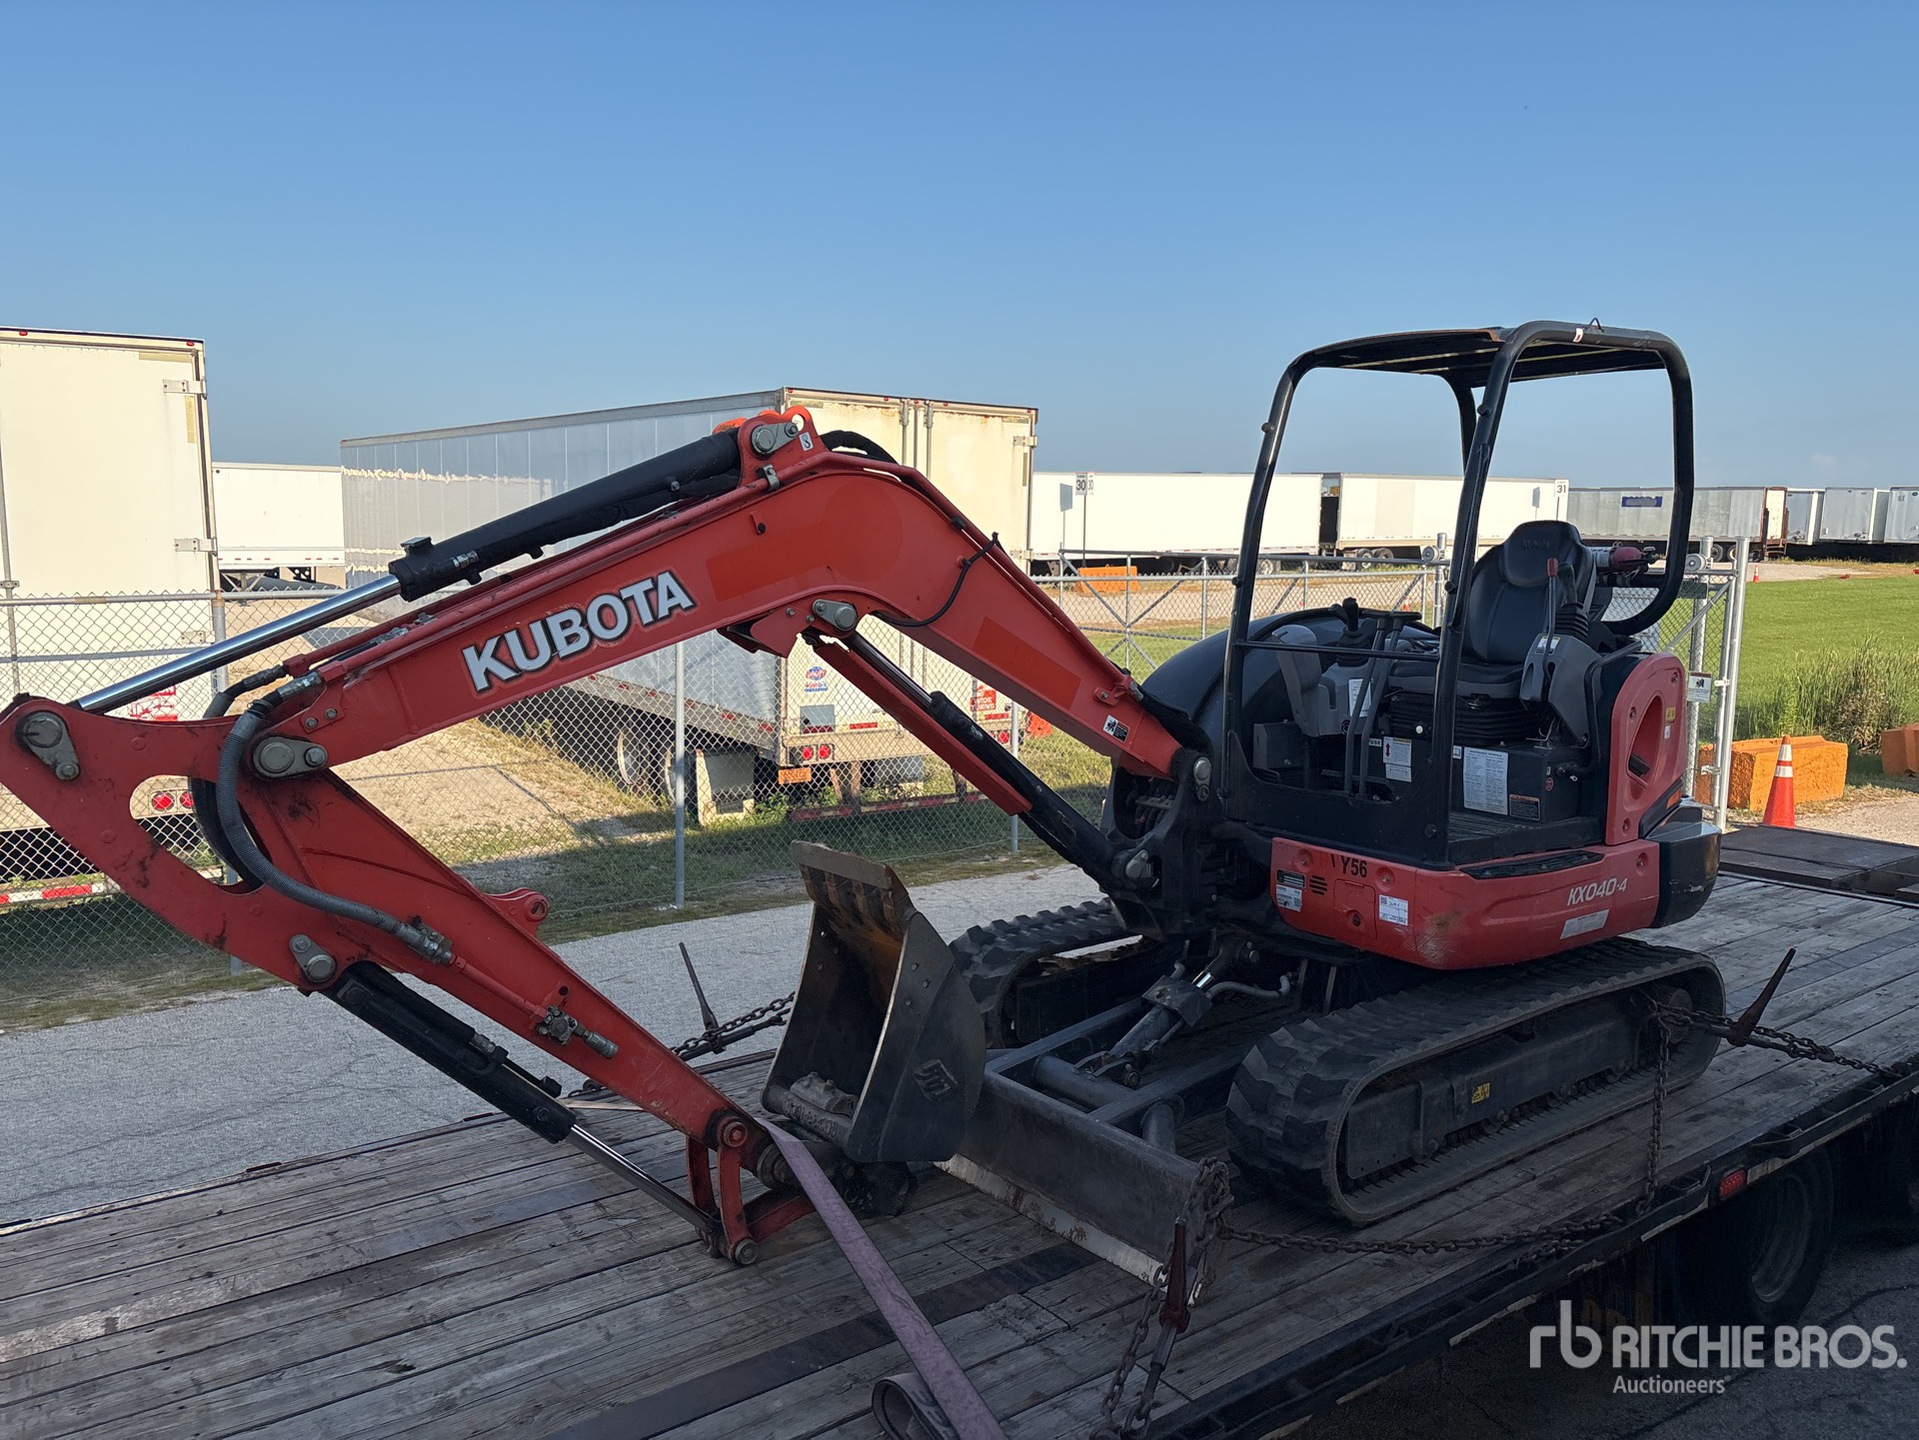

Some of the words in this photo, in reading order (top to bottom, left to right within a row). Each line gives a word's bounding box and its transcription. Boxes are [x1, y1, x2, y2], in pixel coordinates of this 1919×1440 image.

[1076, 479, 1087, 491] 30
[1556, 484, 1567, 493] 31
[461, 569, 697, 692] KUBOTA
[1340, 855, 1368, 878] Y56
[1567, 877, 1628, 906] KX040-4
